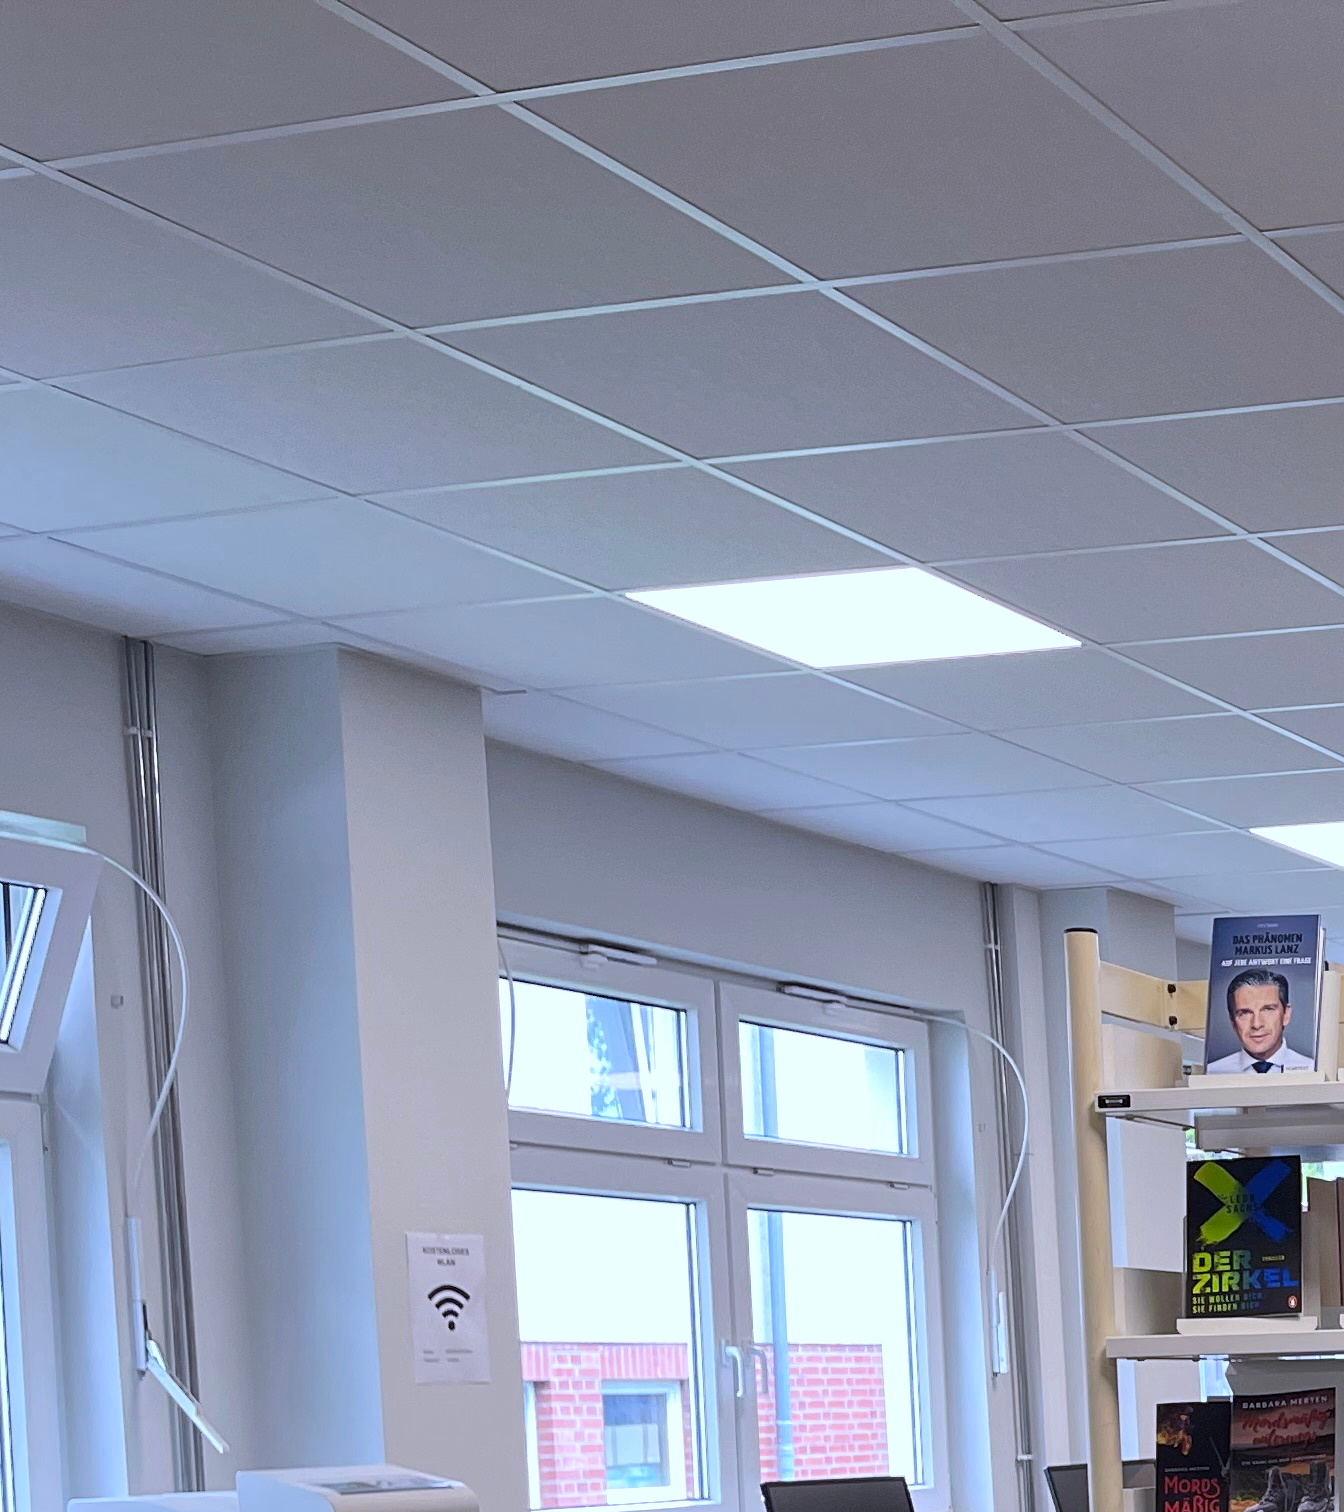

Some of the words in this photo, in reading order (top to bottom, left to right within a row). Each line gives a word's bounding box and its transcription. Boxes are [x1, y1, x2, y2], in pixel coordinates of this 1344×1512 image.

[1233, 935, 1250, 944] DAS
[1252, 932, 1302, 943] PHÄNOMEN
[1235, 945, 1272, 955] MARKUS
[1275, 944, 1299, 954] LANZ
[437, 1258, 456, 1266] WLAN
[1192, 1250, 1250, 1272] DER
[1192, 1267, 1299, 1294] ZIRKEL
[1192, 1296, 1205, 1304] SIE
[1192, 1305, 1205, 1314] SIE
[1208, 1303, 1237, 1312] FINDEN
[1242, 1399, 1287, 1409] BARBARA
[1290, 1396, 1328, 1406] MERTEN
[1164, 1476, 1220, 1498] MORDS
